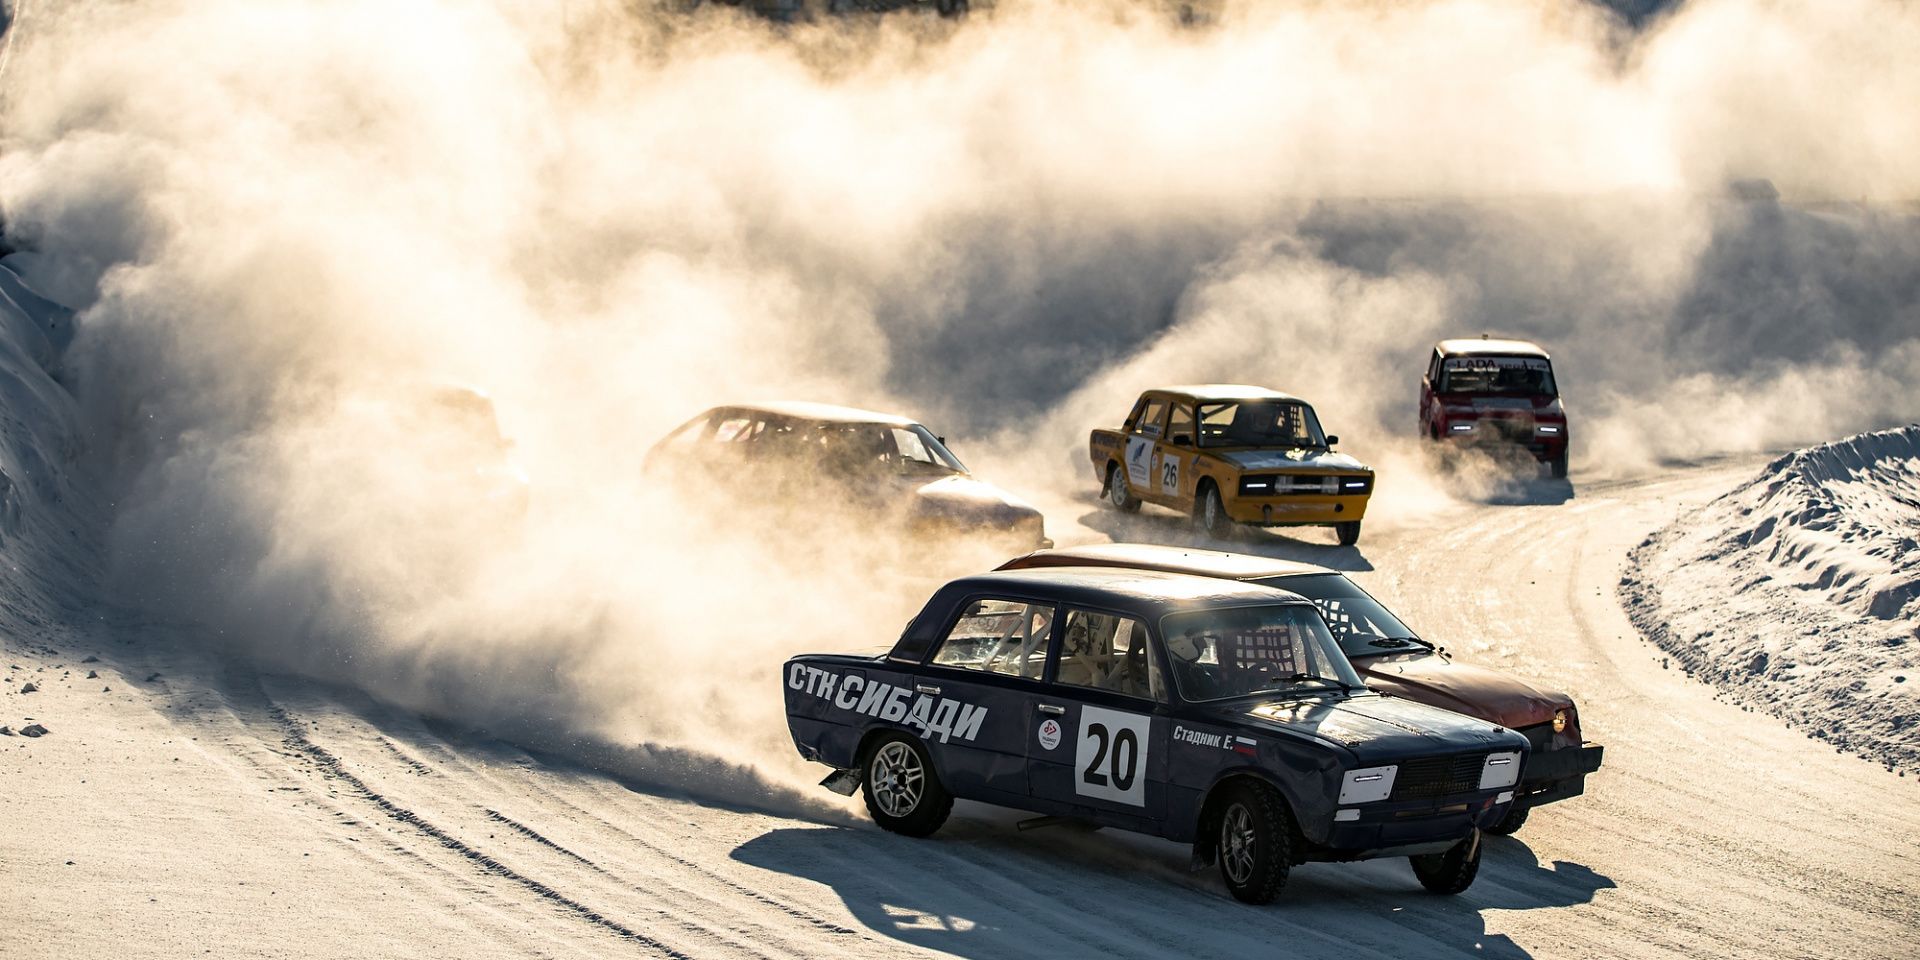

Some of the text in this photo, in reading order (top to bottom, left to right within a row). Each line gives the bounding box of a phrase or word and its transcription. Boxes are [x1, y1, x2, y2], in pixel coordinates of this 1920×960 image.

[1456, 359, 1496, 369] LADA
[1163, 462, 1177, 488] 26
[788, 662, 989, 744] СТК СИБАДИ
[1173, 725, 1221, 748] Стадник
[1083, 722, 1138, 791] 20
